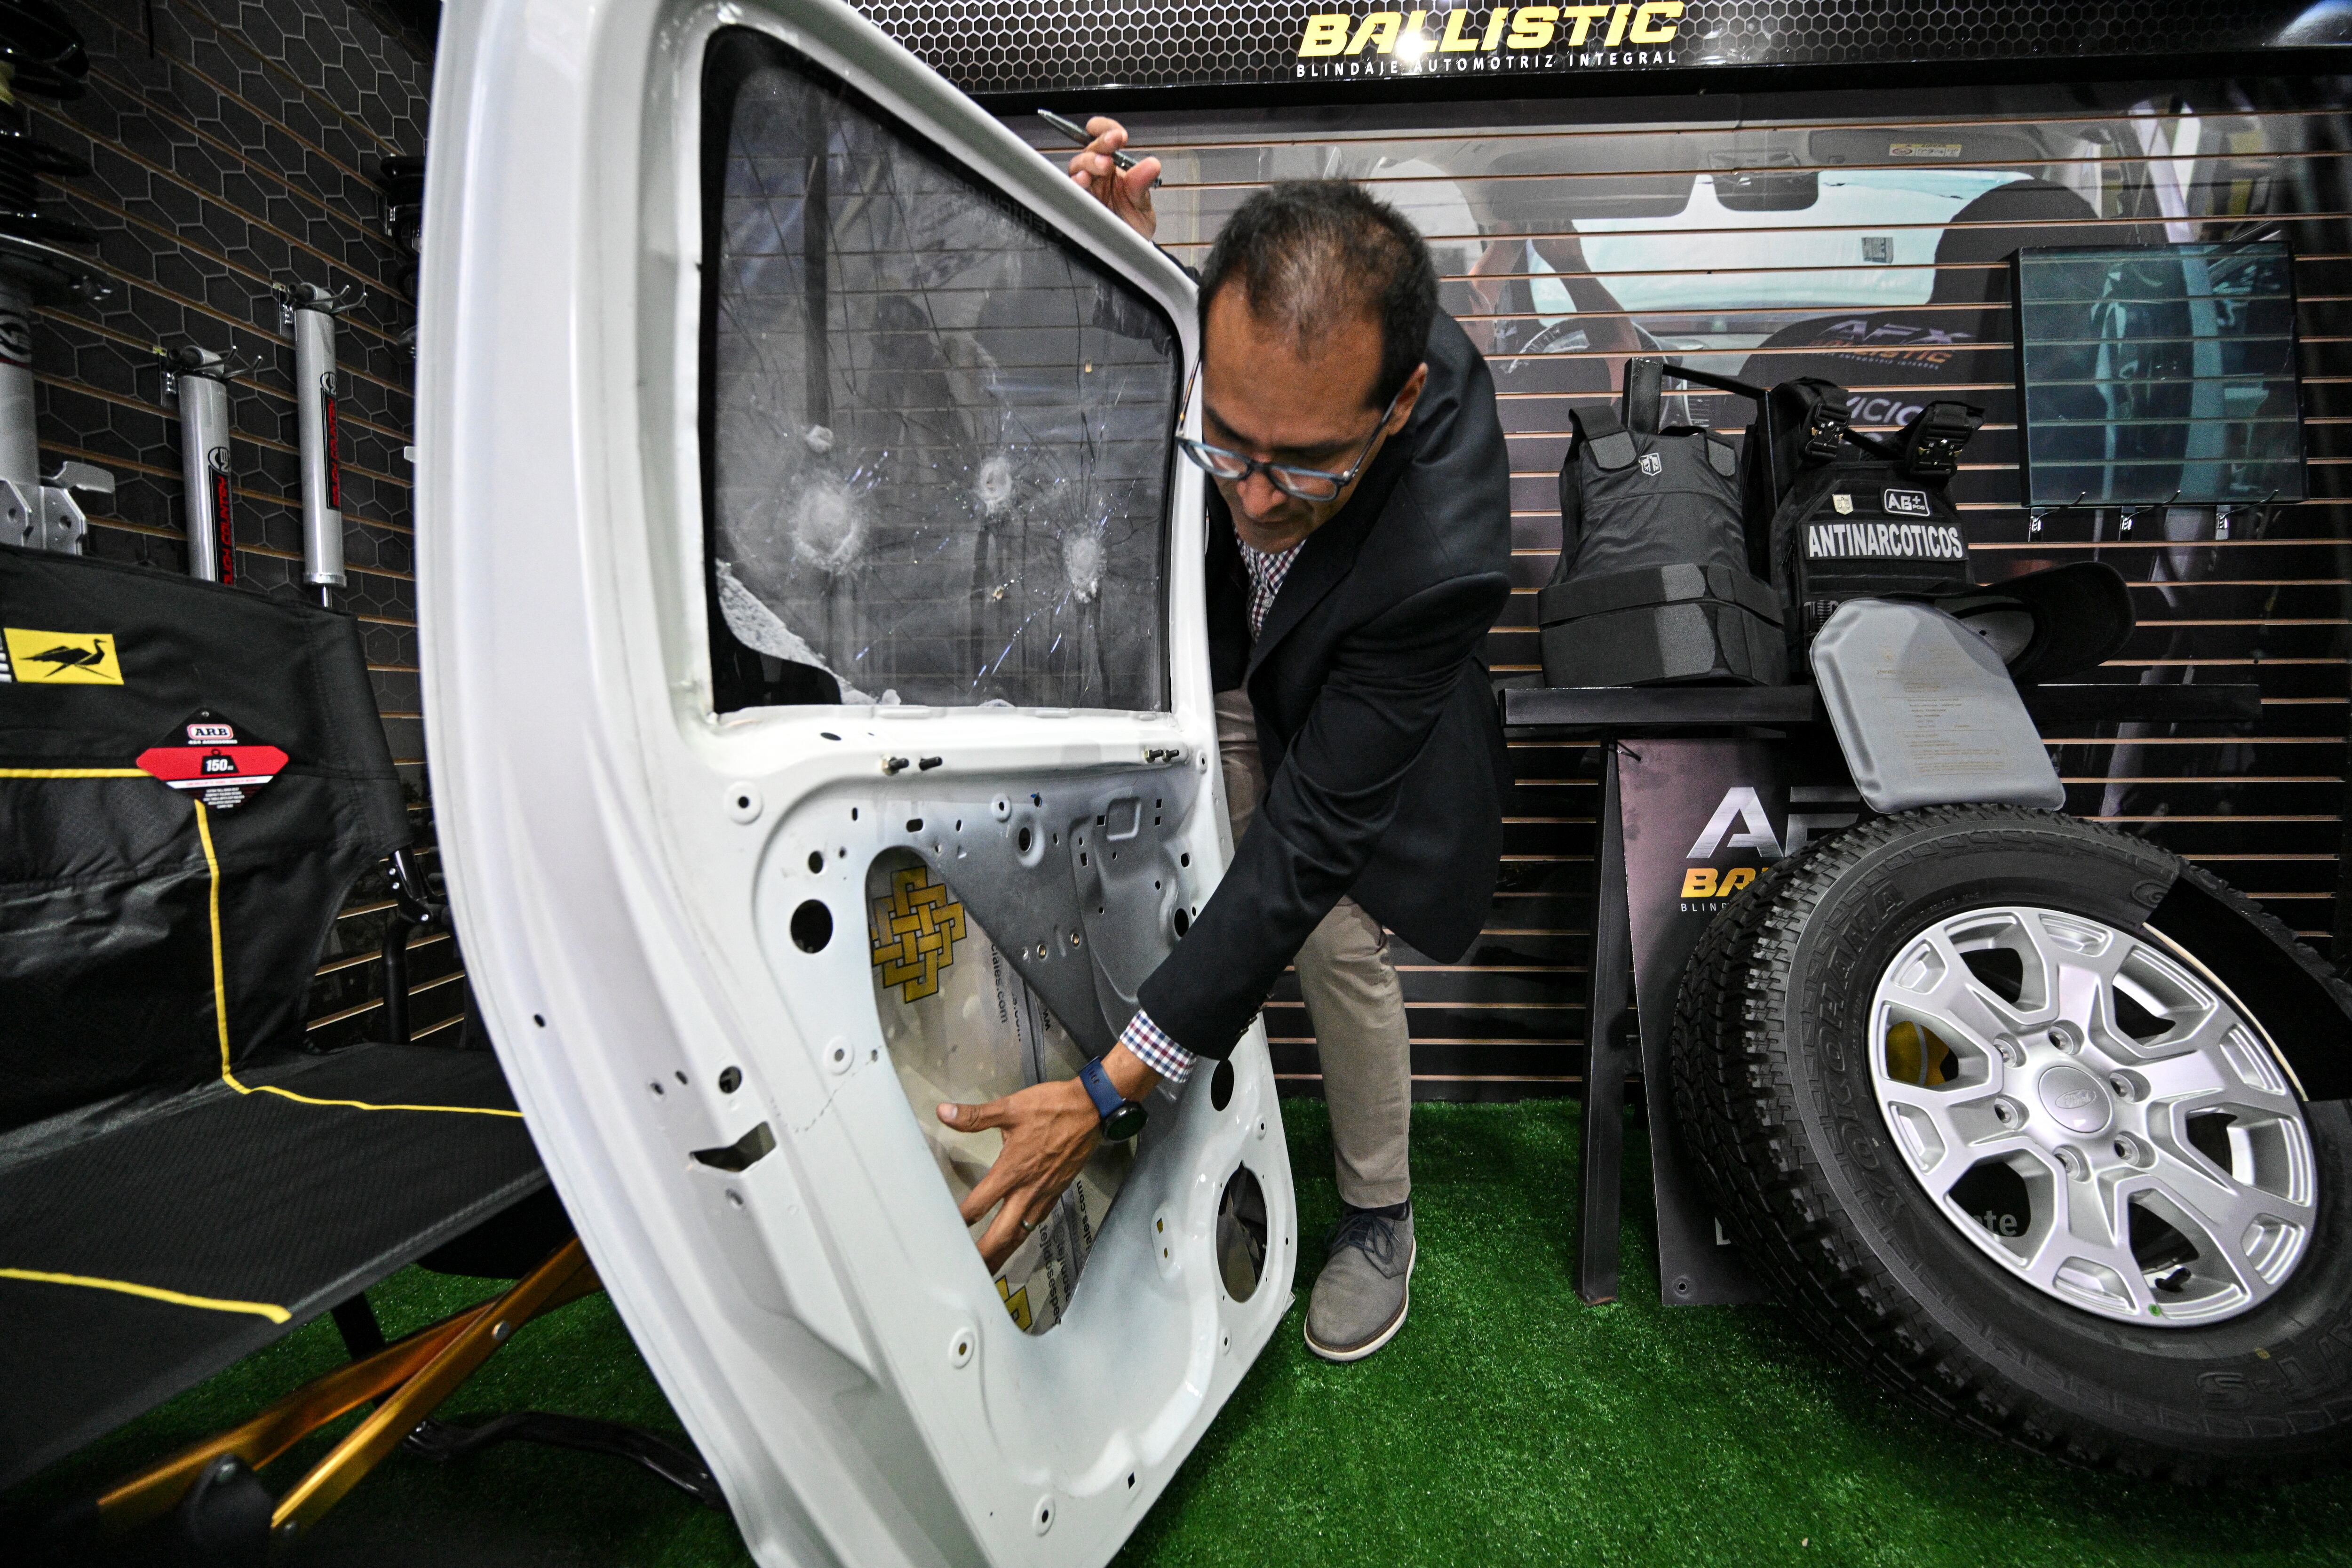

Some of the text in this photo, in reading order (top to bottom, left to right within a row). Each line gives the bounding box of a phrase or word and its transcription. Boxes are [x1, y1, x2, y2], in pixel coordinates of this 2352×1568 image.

[1298, 1, 1685, 57] BALLISTIC
[1297, 51, 1677, 78] BLINDAJE AUTOMOTRIZ INTEGRAL
[1846, 396, 1924, 426] ICIO
[218, 476, 234, 586] OUGH COUNTRY
[1809, 524, 1963, 558] ANTINARCOTICOS
[206, 758, 228, 772] 150
[1681, 868, 1769, 898] BA
